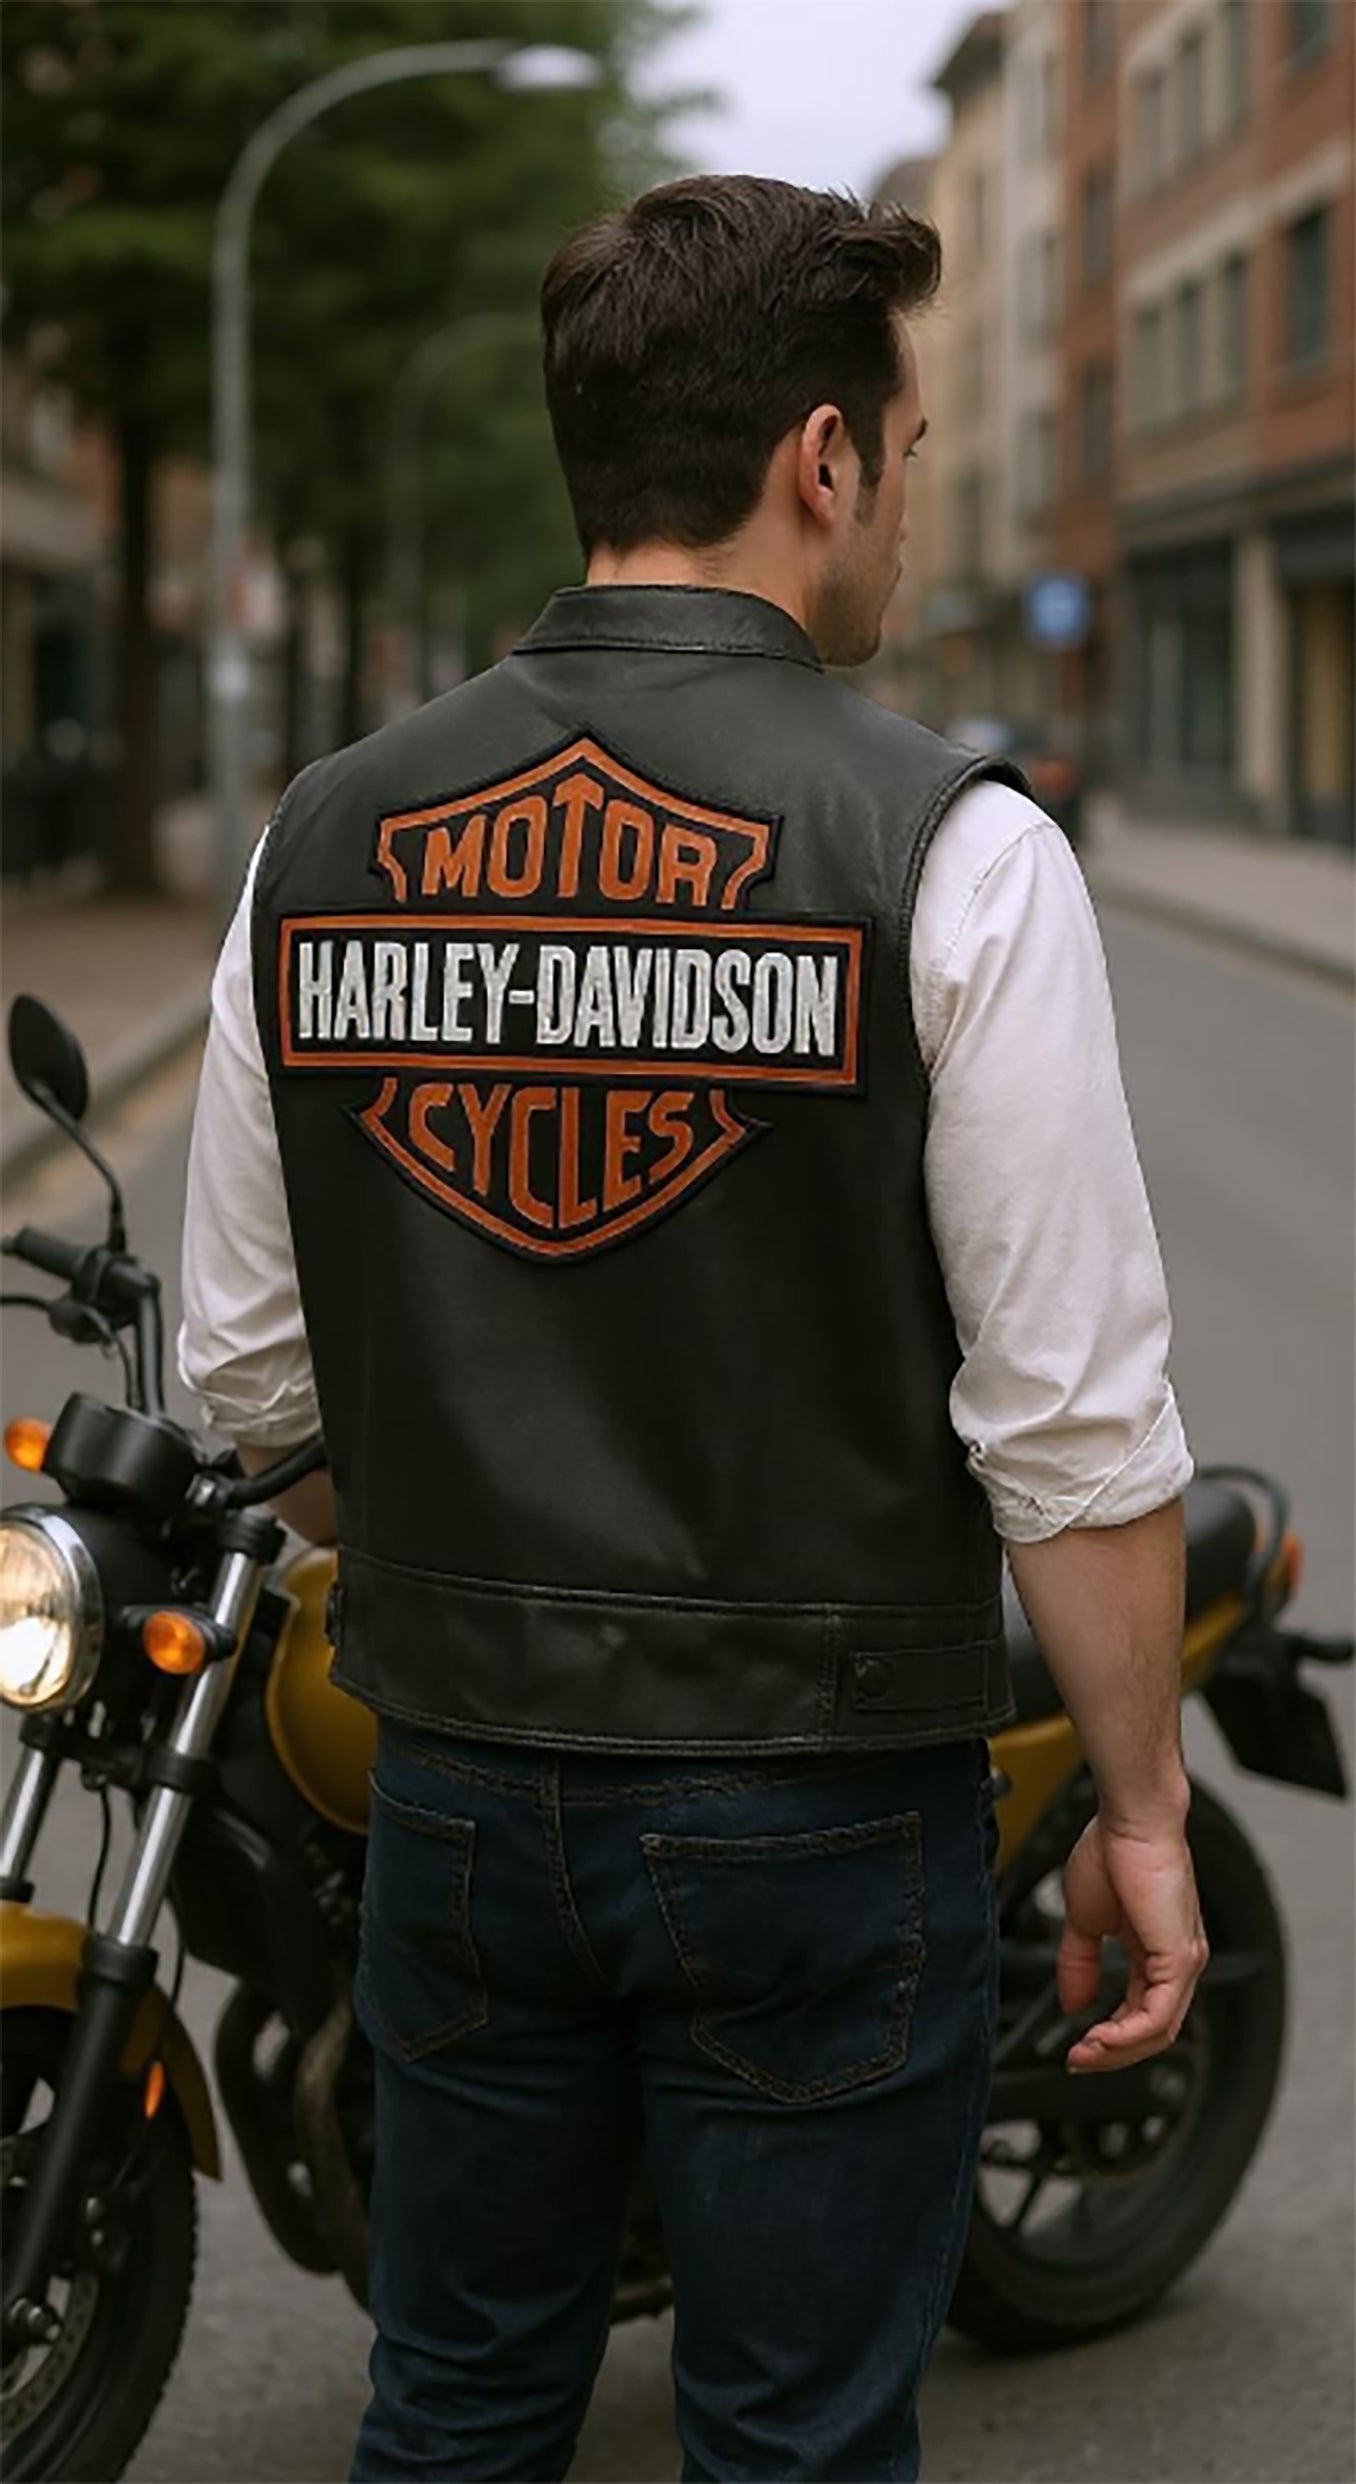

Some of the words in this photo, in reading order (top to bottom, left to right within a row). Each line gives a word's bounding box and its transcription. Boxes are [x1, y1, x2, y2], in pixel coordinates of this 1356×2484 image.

[421, 773, 717, 906] MOTOR
[298, 939, 839, 1056] HARLEY-DAVIDSON
[408, 1082, 695, 1230] CYCLES
